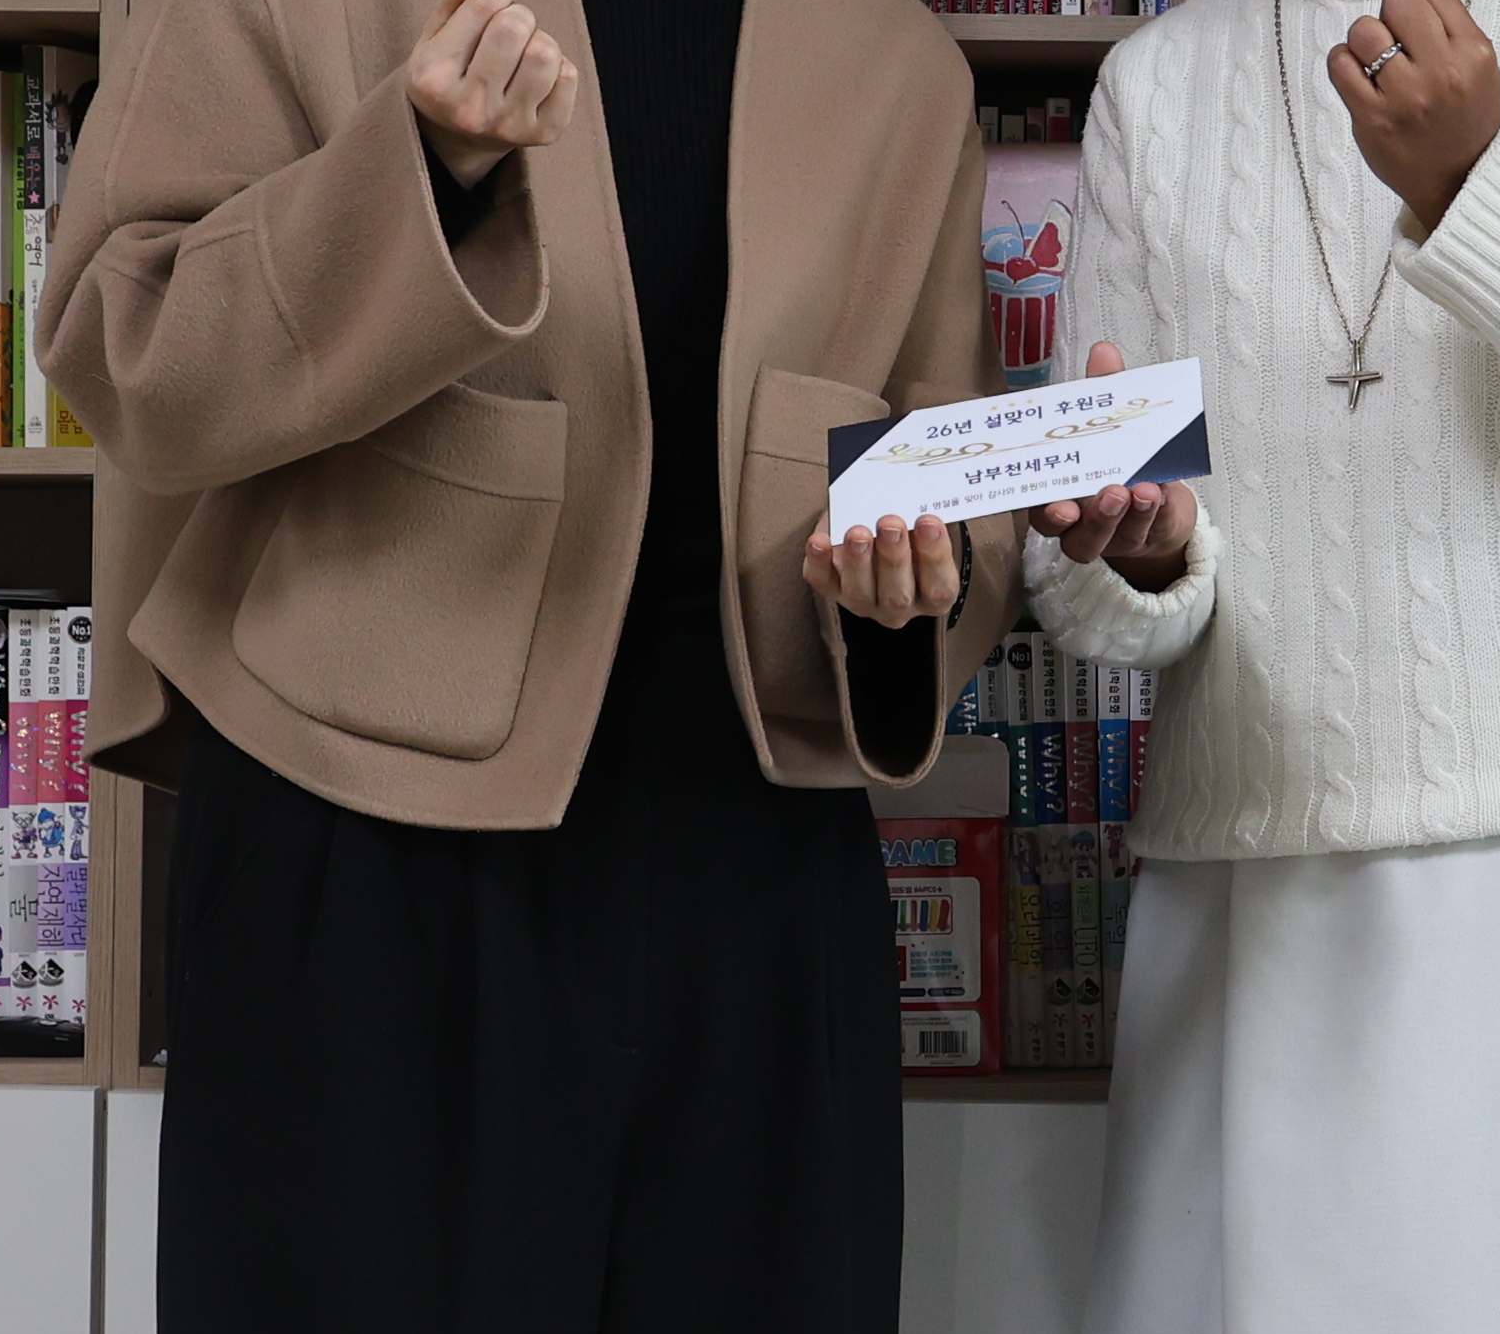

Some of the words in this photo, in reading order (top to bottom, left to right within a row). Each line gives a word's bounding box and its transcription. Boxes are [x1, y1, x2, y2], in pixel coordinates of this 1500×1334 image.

[24, 75, 41, 142] 교과서로
[25, 145, 41, 190] 배우는
[926, 419, 973, 440] 26년
[983, 405, 1043, 429] 설맞이
[1054, 392, 1115, 415] 후원금
[918, 503, 928, 513] 설
[932, 497, 960, 511] 명절을
[964, 492, 983, 504] 맞아
[988, 485, 1015, 499] 감사와
[1020, 480, 1048, 493] 응원의
[1051, 474, 1080, 487] 마음을
[1084, 467, 1125, 482] 전합니다.
[964, 450, 1081, 486] 남부천세무서
[9, 895, 39, 922] 물
[38, 866, 66, 947] 자연재해
[1076, 930, 1099, 968] UFO
